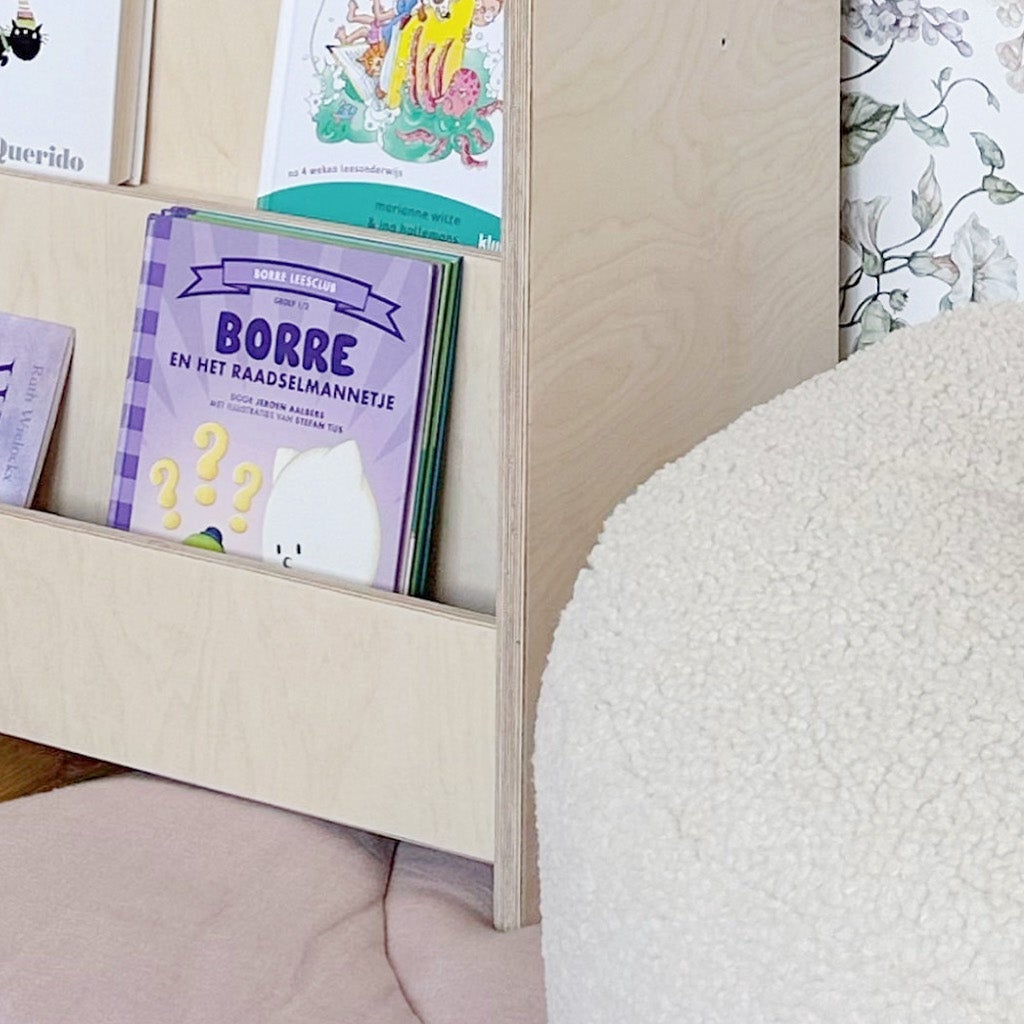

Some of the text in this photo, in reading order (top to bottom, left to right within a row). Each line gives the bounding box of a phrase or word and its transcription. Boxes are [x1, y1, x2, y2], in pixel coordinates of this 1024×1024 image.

[254, 269, 337, 293] BORRE LEESCLUB
[215, 311, 358, 377] BORRE
[170, 351, 396, 411] EN HET RAADSELMANNETJE
